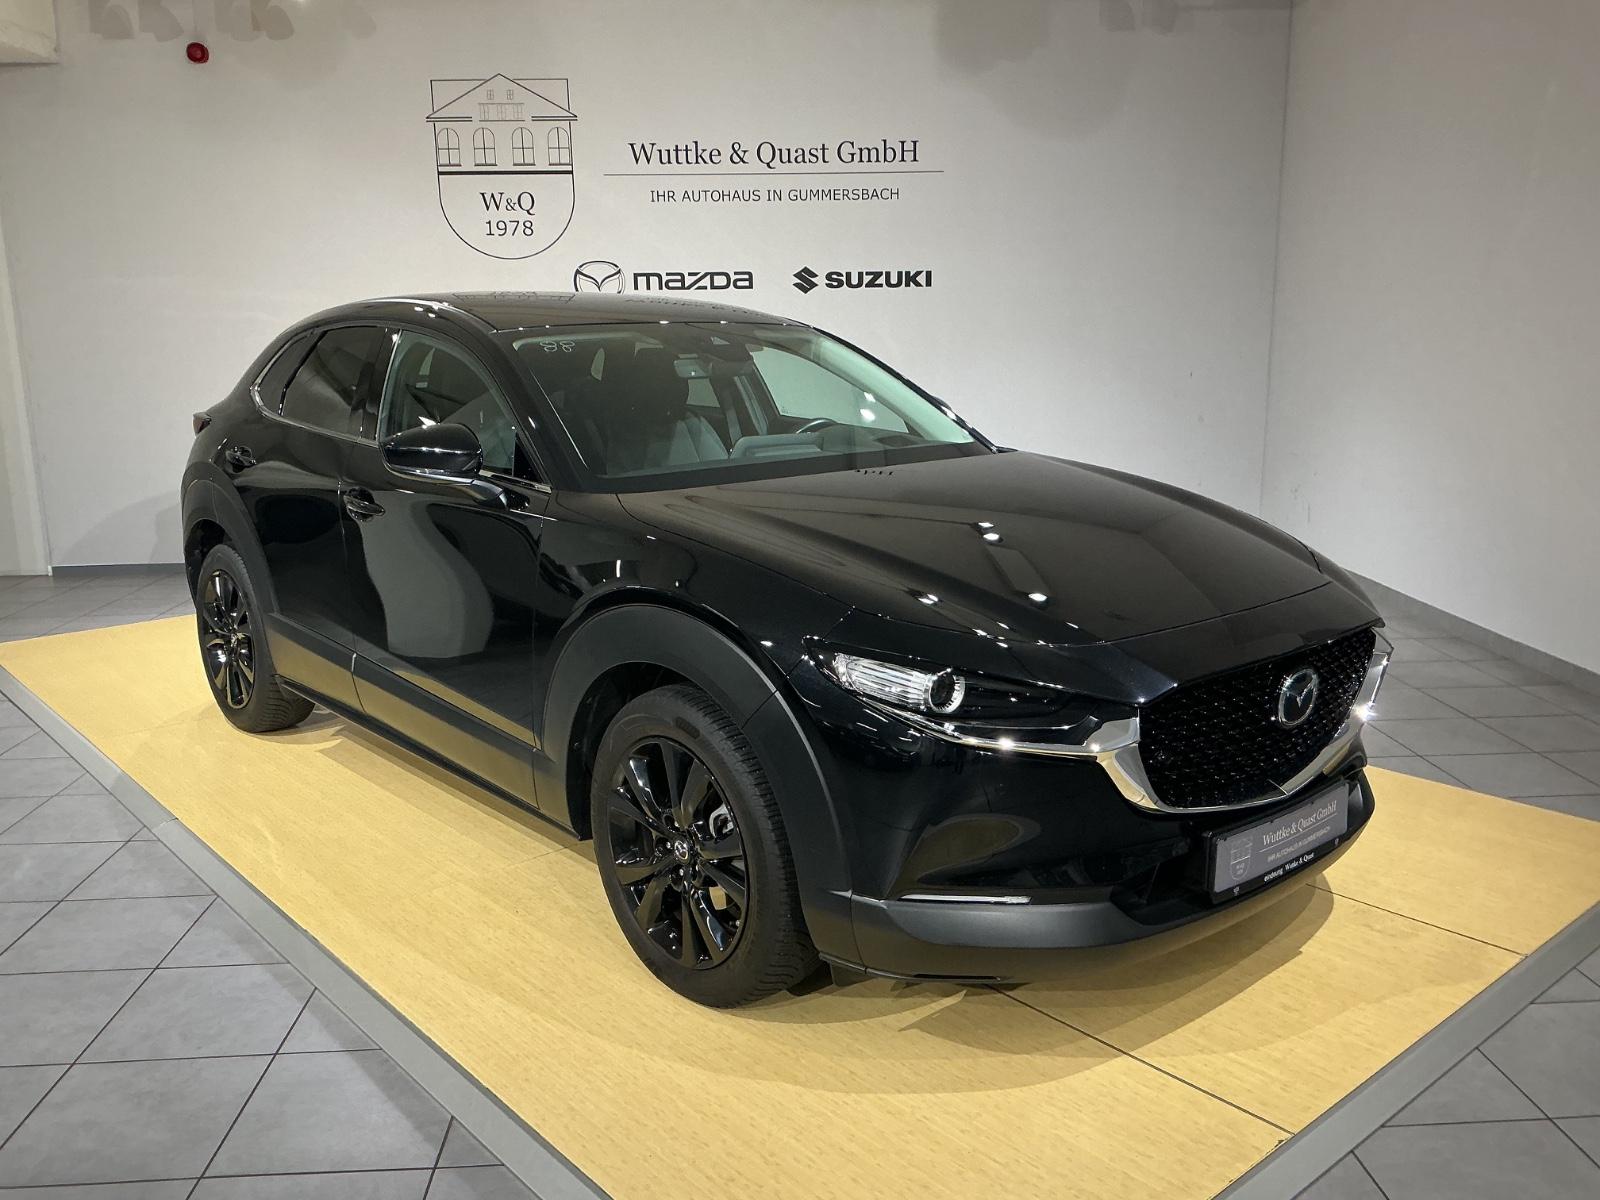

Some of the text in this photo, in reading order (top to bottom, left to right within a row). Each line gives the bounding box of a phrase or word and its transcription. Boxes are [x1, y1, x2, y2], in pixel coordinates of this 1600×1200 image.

[627, 138, 920, 169] Wuttke & Quast GmbH
[479, 191, 536, 216] W&Q
[649, 187, 900, 203] IHR AUTOHAUS IN GUMMERSBACH
[484, 219, 535, 238] 1978
[824, 269, 933, 290] SUZUKI
[1263, 800, 1337, 846] Wuttke & Quast GmbH
